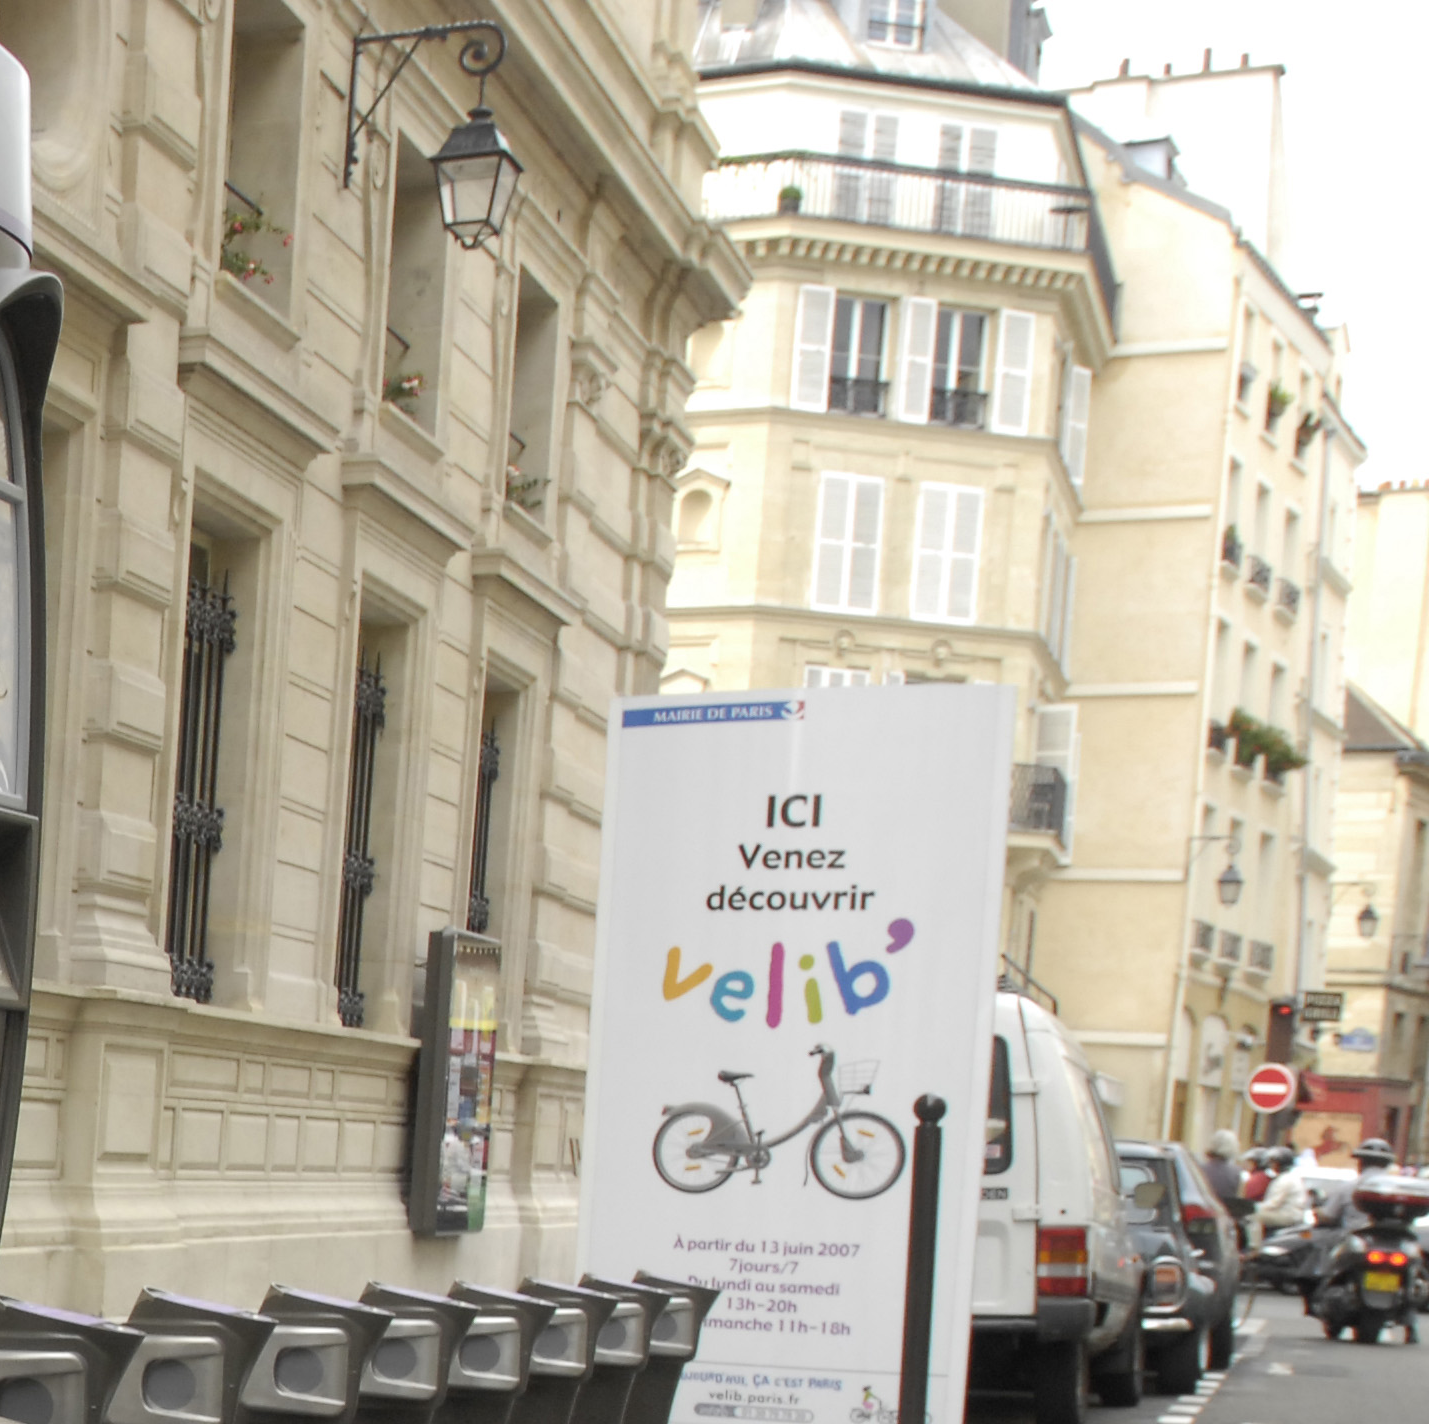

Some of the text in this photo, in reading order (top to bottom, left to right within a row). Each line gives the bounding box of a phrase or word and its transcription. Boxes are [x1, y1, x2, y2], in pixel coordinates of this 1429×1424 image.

[653, 705, 773, 723] MAIRIE DE PARIS
[765, 794, 822, 828] ICI
[738, 844, 846, 869] Venez
[705, 884, 876, 911] découvrir
[663, 917, 915, 1029] velib'
[687, 1239, 732, 1251] partir
[735, 1239, 755, 1252] du
[761, 1241, 779, 1254] 13
[783, 1242, 813, 1256] juin
[818, 1243, 861, 1257] 2007
[711, 1277, 751, 1291] lundi
[755, 1282, 775, 1293] au
[779, 1282, 840, 1296] samedi
[726, 1297, 797, 1313] 13h-20h
[702, 1316, 851, 1335] imanche 11h-18h
[808, 1378, 843, 1391] PARIS
[708, 1389, 800, 1405] velib.paris.fr
